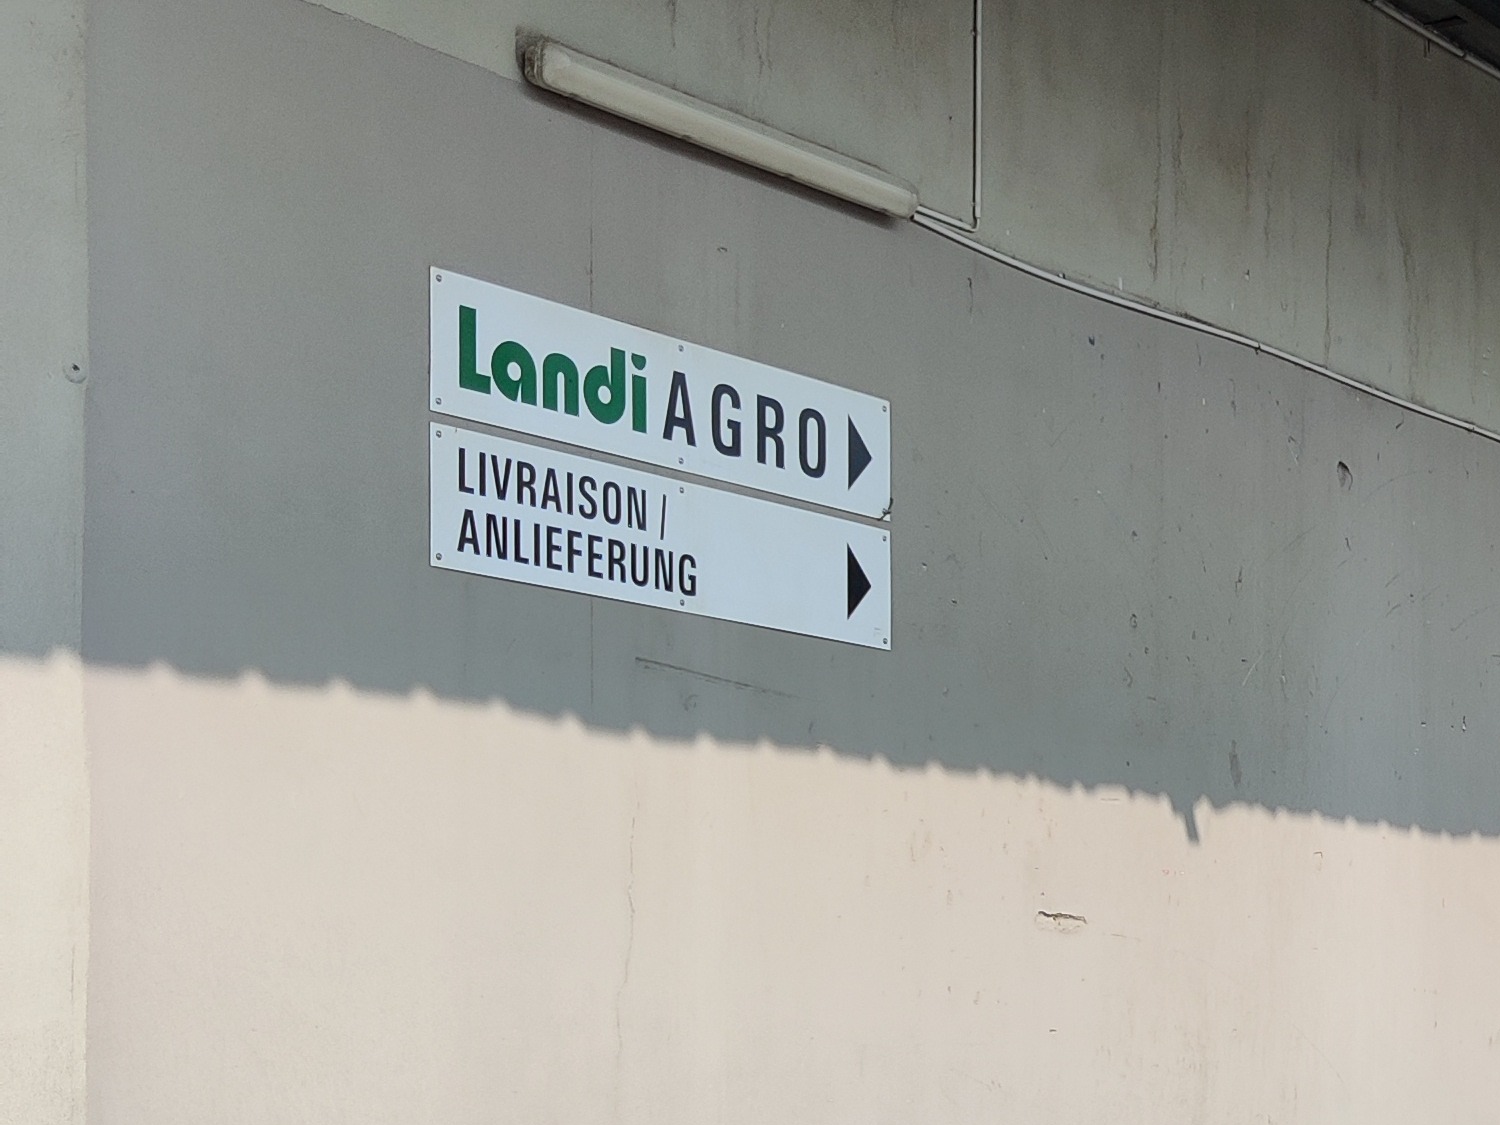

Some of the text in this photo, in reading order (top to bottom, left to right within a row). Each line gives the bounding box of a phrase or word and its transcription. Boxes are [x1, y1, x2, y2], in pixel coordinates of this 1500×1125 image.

[458, 304, 827, 479] Landi AGRO
[458, 447, 648, 532] LIVRAISON
[456, 508, 698, 598] ANLIEFERUNG
